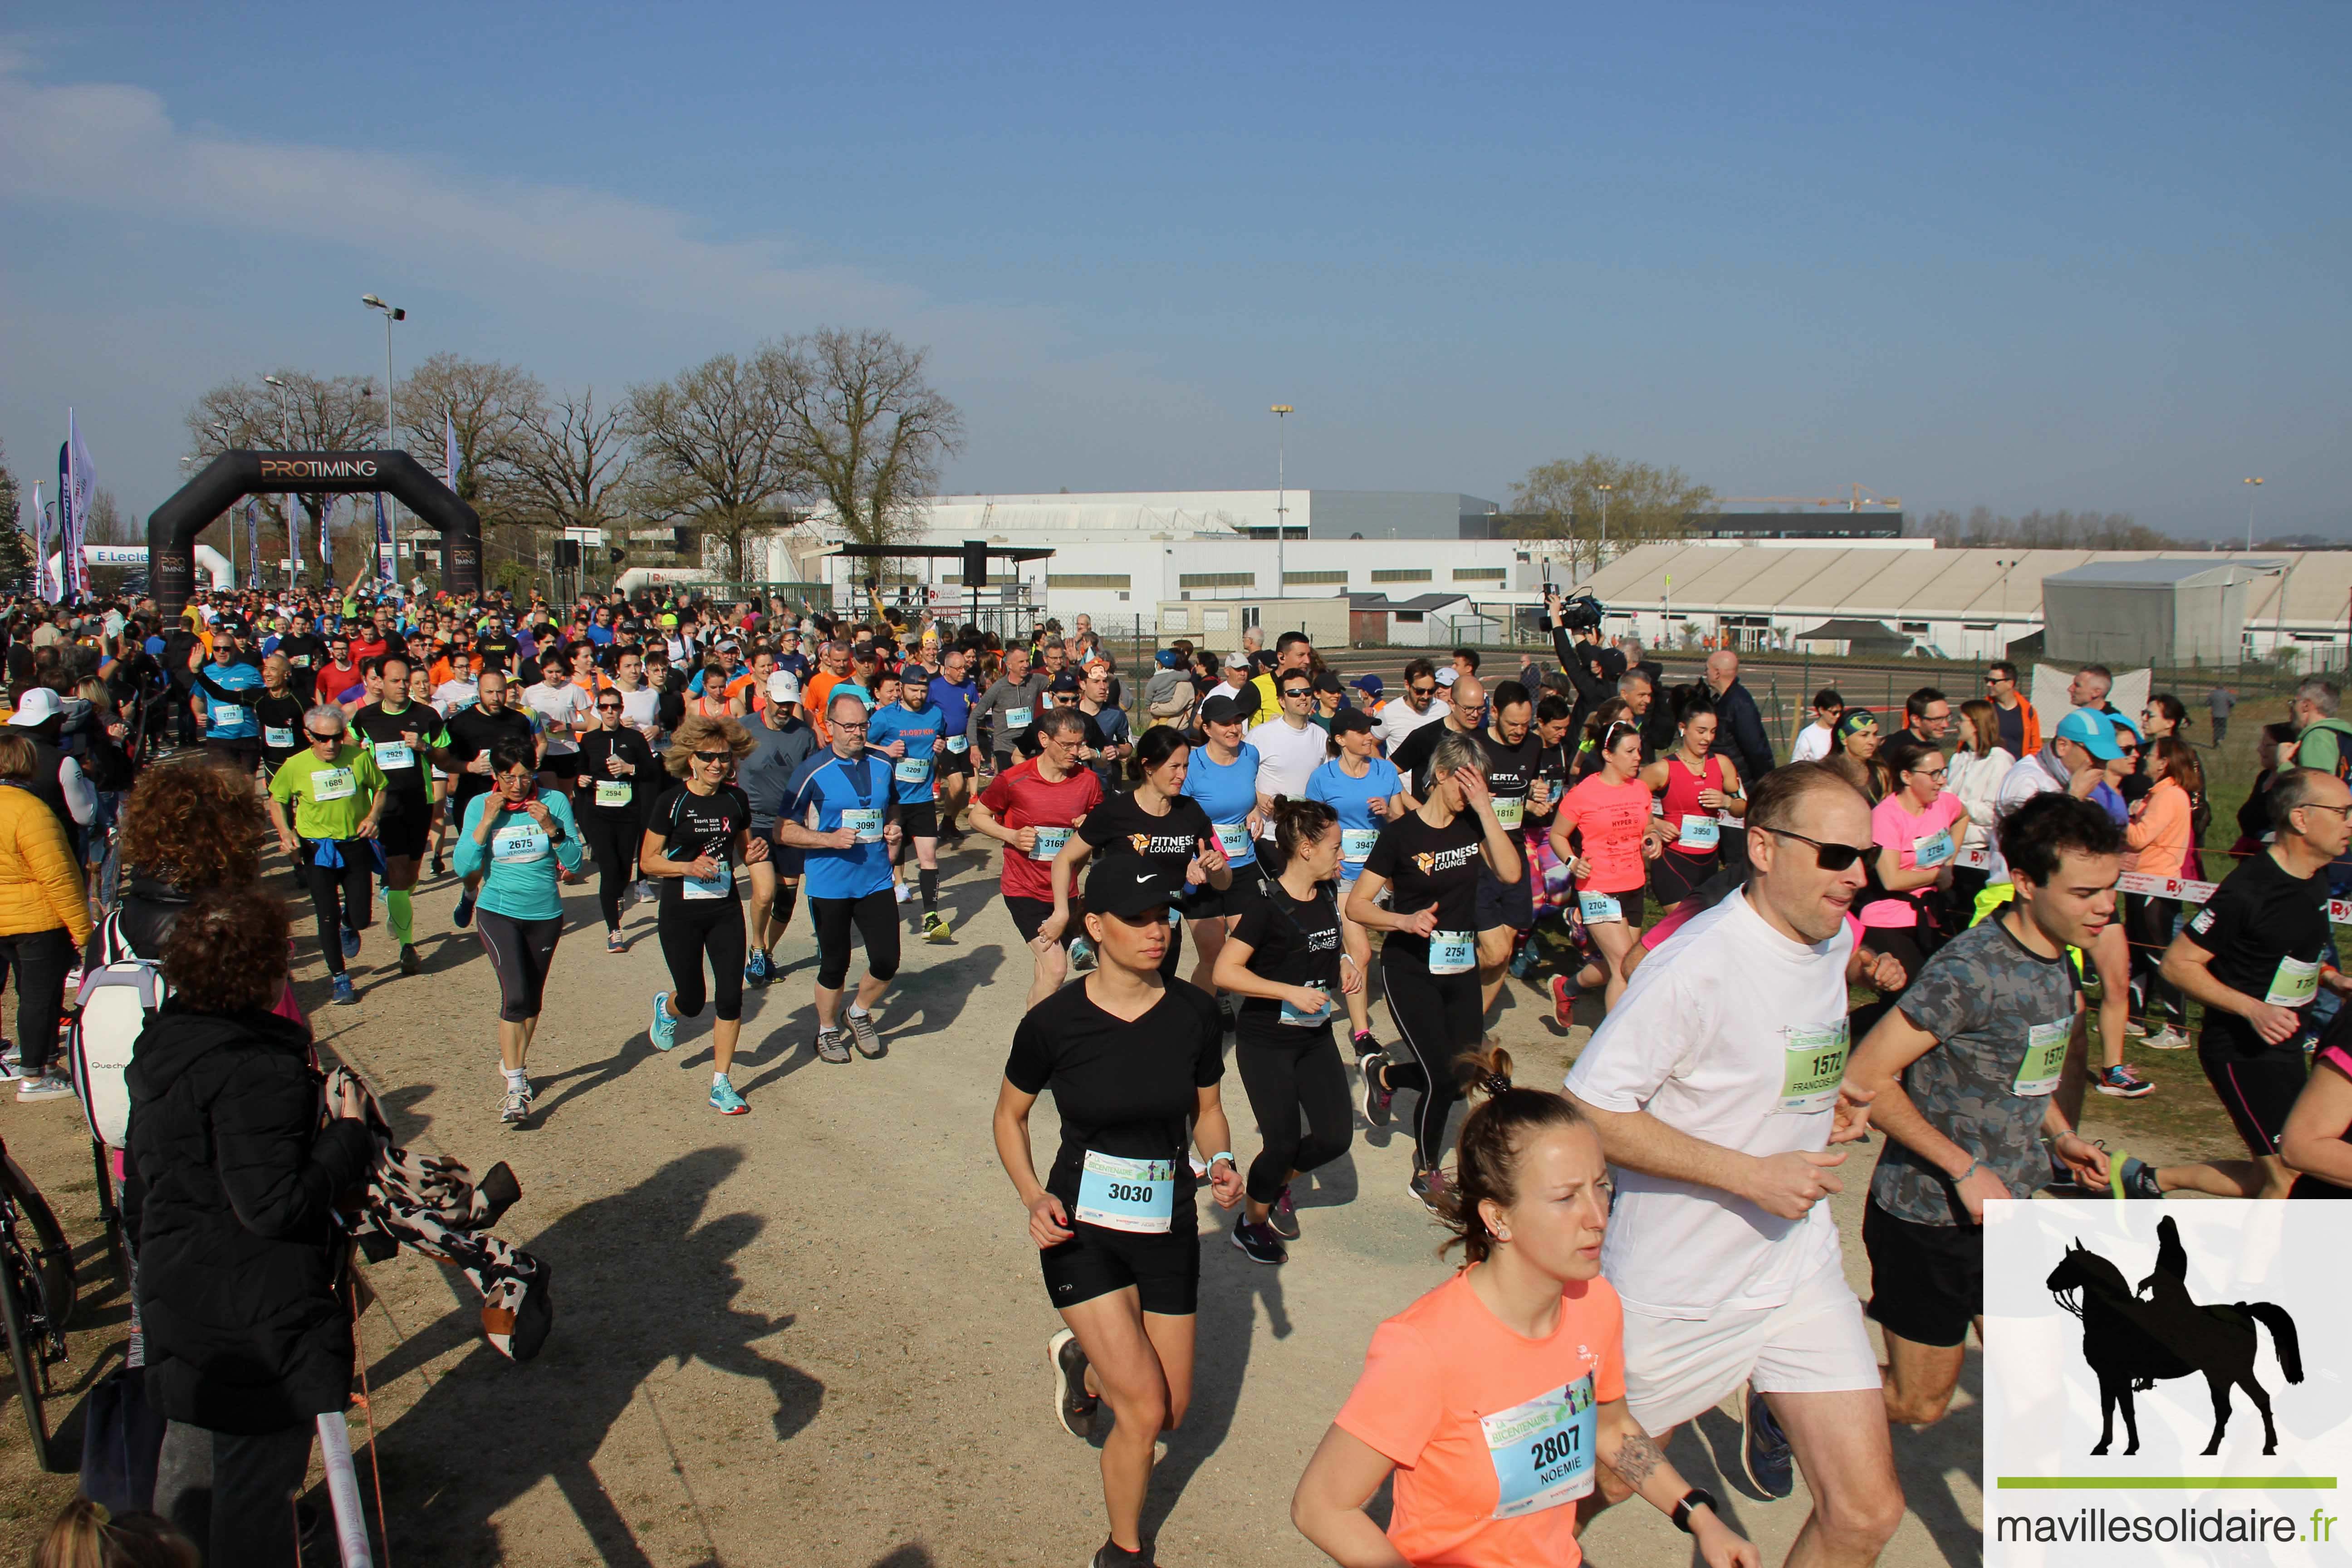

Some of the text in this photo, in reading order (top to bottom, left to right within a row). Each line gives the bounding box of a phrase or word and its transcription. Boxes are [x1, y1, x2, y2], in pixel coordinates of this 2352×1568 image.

[261, 461, 377, 476] PROTIMING
[161, 557, 186, 566] PRO
[454, 550, 475, 559] PRO
[324, 779, 343, 788] 1689
[509, 839, 533, 849] 2675
[1045, 839, 1064, 848] 3169
[1151, 834, 1194, 846] FITNESS
[1224, 835, 1241, 844] 3947
[1435, 843, 1479, 864] FITNESS
[1435, 857, 1466, 871] LOUNGE
[2166, 879, 2186, 897] Ry
[1588, 901, 1607, 910] 2704
[1446, 947, 1465, 956] 2754
[2044, 1045, 2064, 1065] 1573
[1813, 1051, 1842, 1076] 1572
[1088, 1161, 1133, 1176] BICENTENAIRE
[1108, 1183, 1152, 1202] 3030
[1492, 1411, 1551, 1443] BICENTENAIRE
[1531, 1424, 1579, 1471] 2807
[1540, 1456, 1583, 1485] NOEMIE
